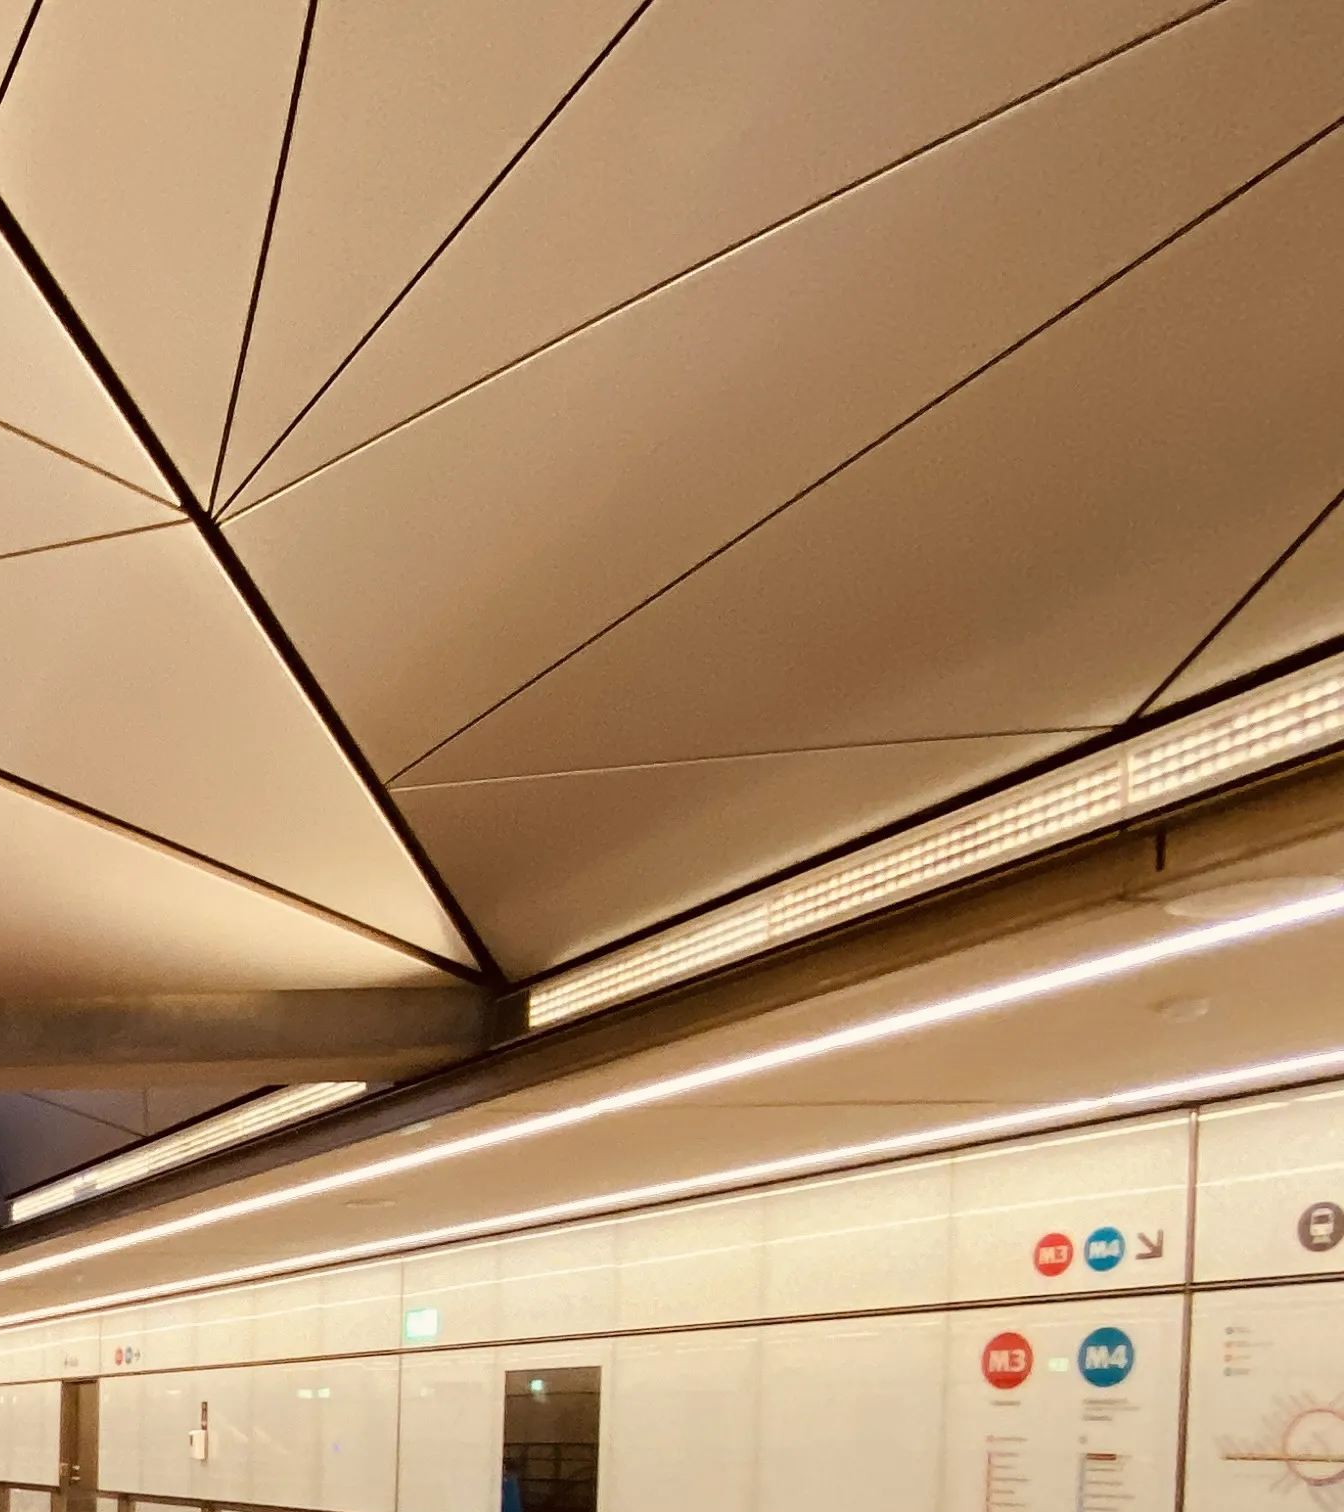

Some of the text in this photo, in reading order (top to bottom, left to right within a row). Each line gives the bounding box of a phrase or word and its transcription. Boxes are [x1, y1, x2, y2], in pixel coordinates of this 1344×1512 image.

[1038, 1239, 1119, 1265] M3 M4
[988, 1345, 1128, 1372] M3 M4
